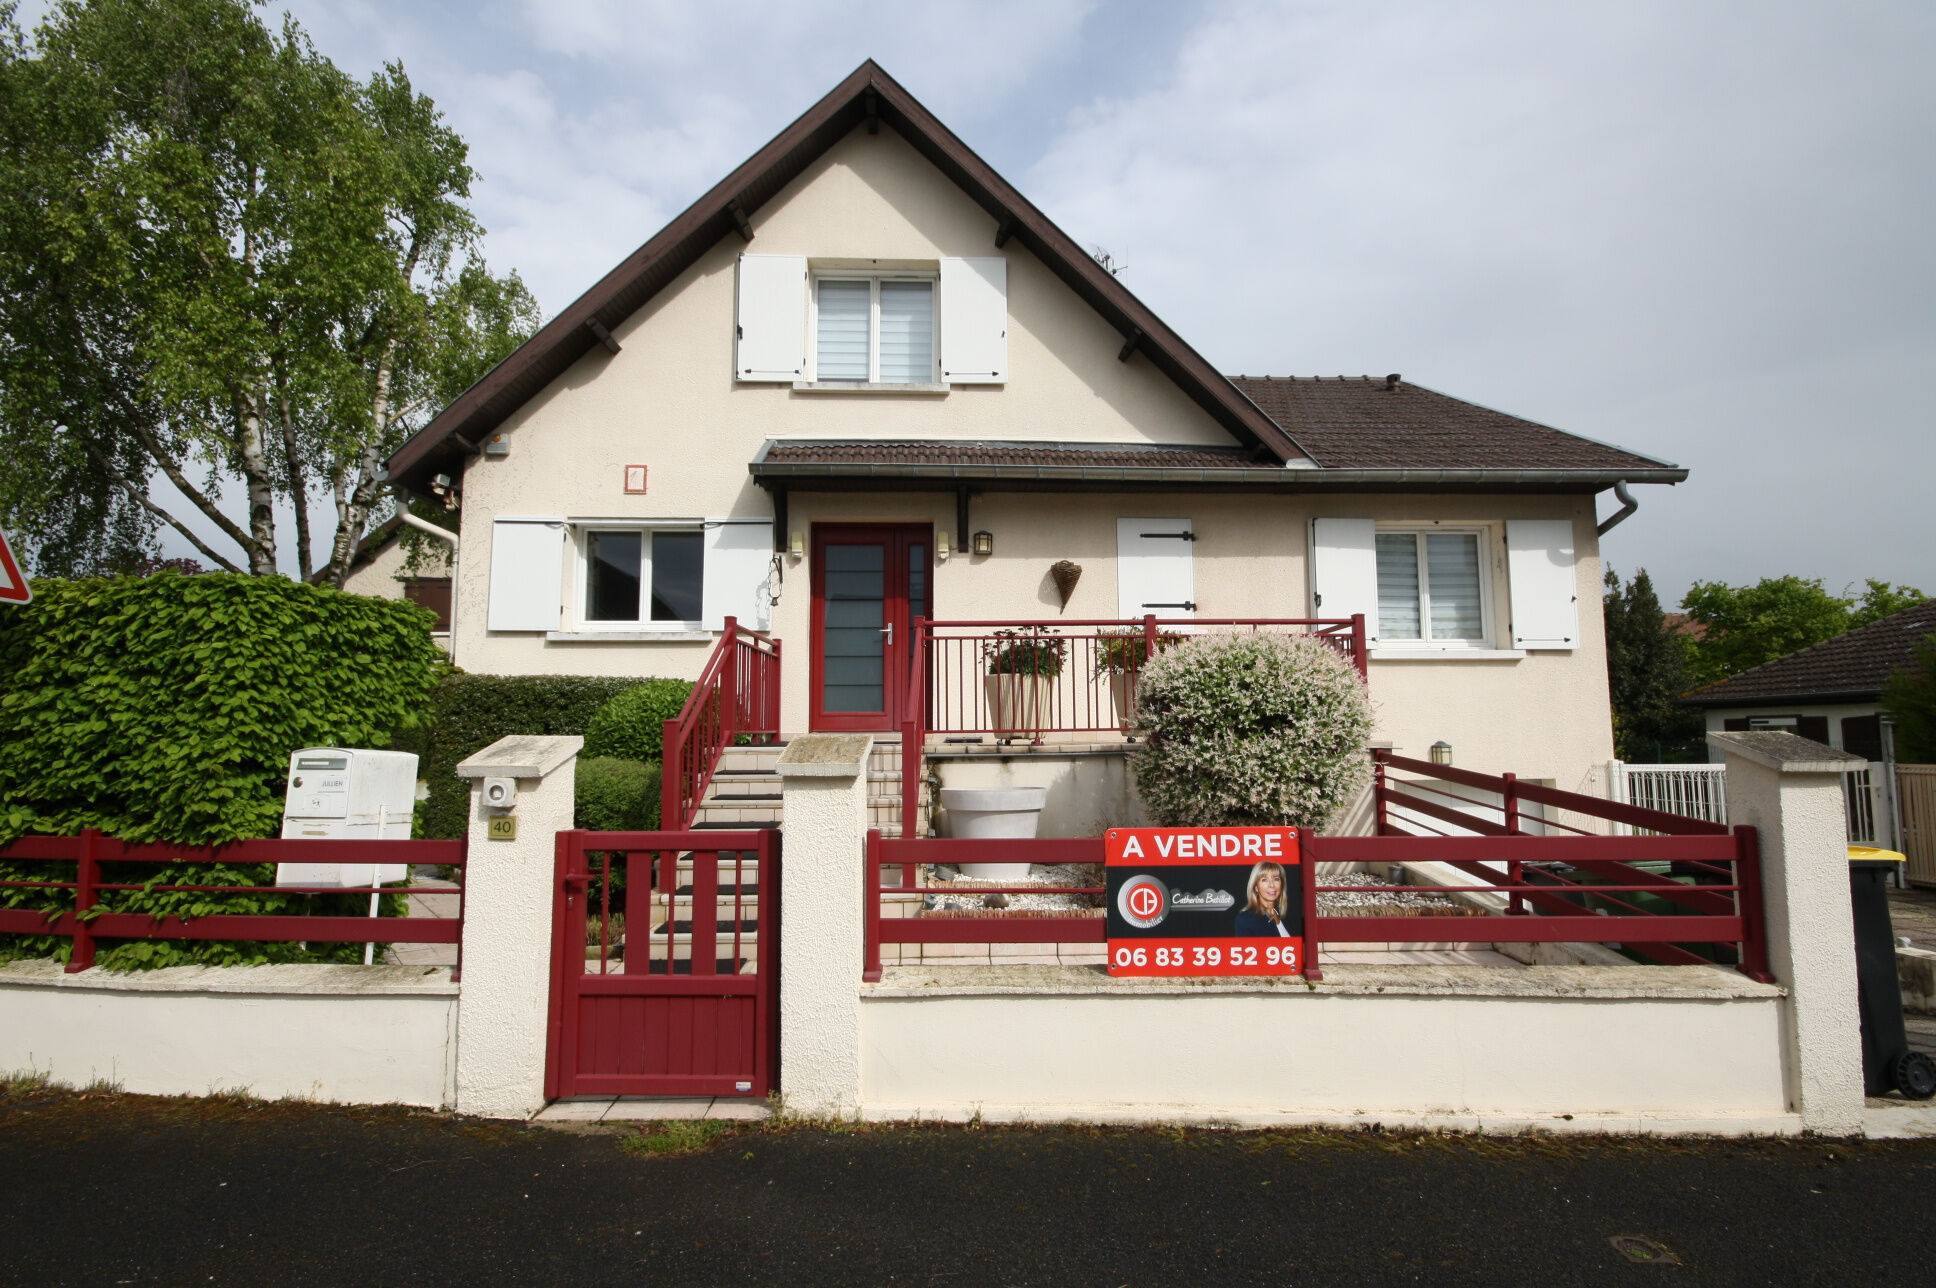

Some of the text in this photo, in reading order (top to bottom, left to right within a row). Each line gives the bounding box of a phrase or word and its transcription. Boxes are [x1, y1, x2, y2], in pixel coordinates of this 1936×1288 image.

[493, 821, 511, 833] 40
[1122, 834, 1283, 858] A VENDRE
[1172, 893, 1204, 904] Catherine
[1115, 946, 1296, 967] 06 83 39 52 96
